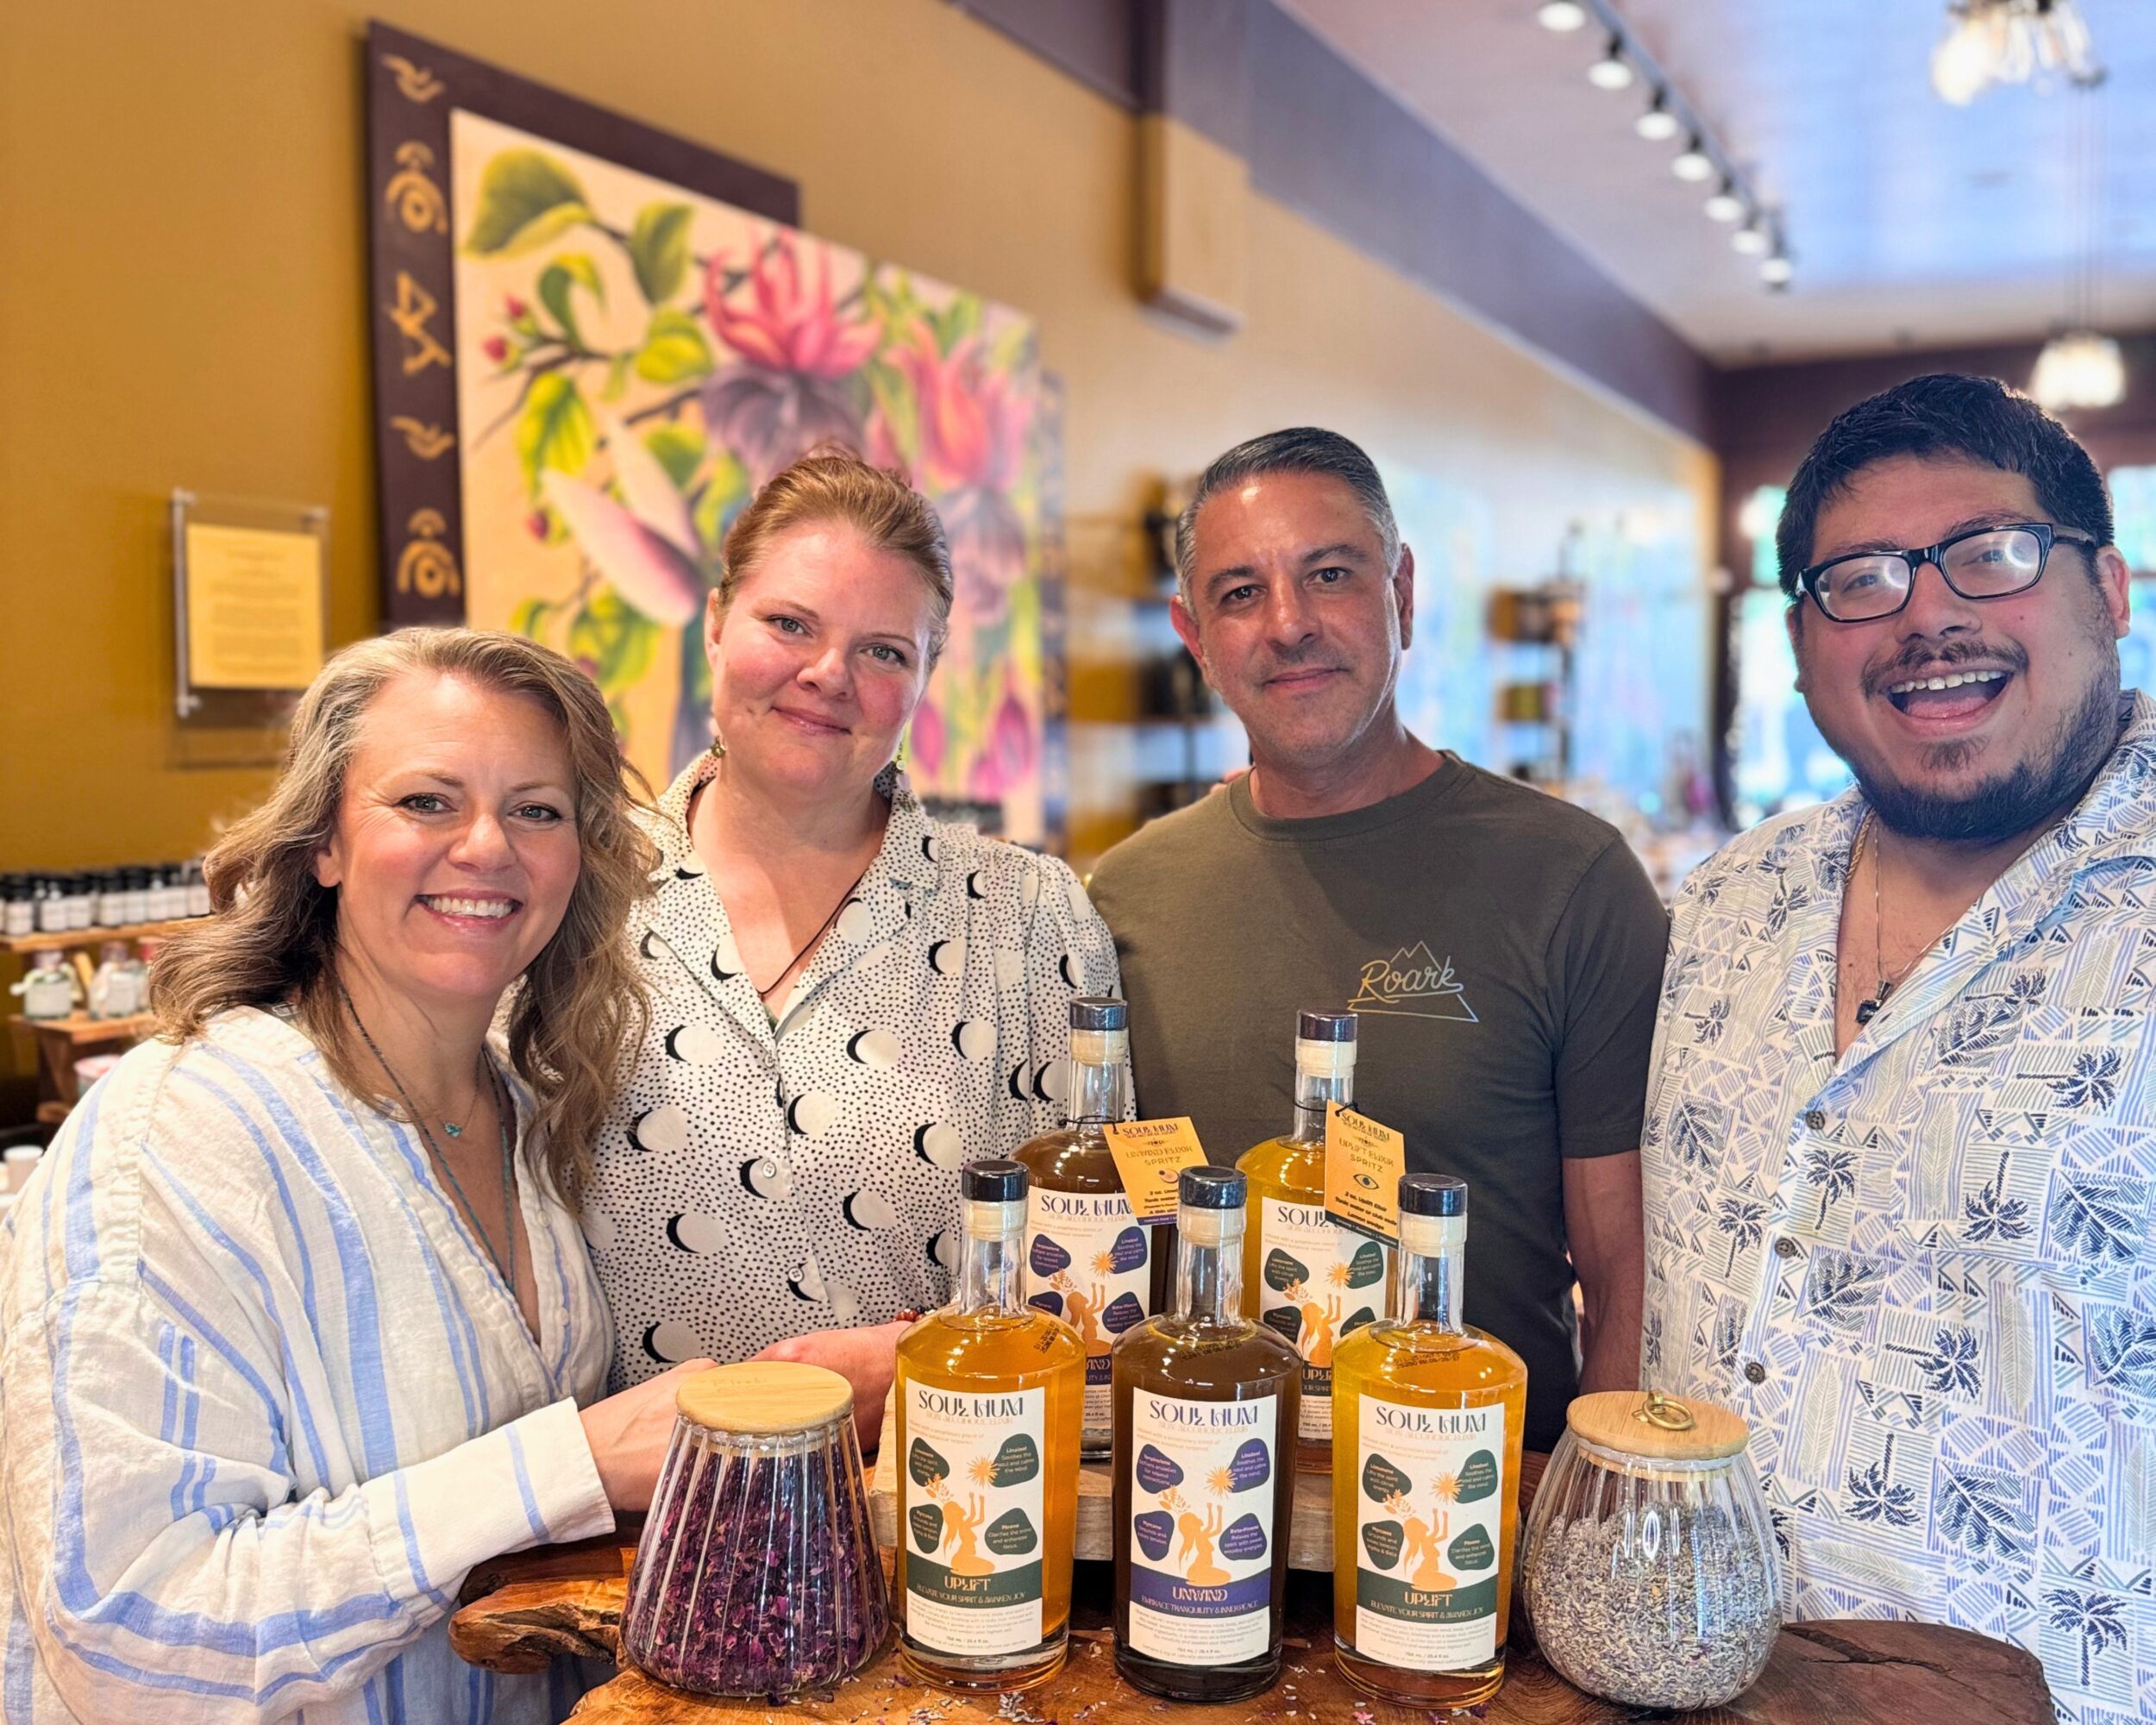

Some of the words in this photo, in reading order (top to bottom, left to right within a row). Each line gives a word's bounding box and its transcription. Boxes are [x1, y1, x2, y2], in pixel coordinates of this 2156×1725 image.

[1358, 955, 1463, 1003] Roark
[1123, 1126, 1151, 1135] SOUL
[1153, 1124, 1178, 1133] HUM
[1341, 1113, 1366, 1130] SOUL
[1368, 1125, 1389, 1141] HUM
[1126, 1149, 1163, 1158] UNWIND
[1164, 1146, 1193, 1154] ELIXIR
[1145, 1156, 1182, 1165] SPRITZ
[1339, 1137, 1367, 1155] UPLIFT
[1368, 1150, 1394, 1167] ELIXIR
[1350, 1154, 1383, 1173] SPRITZ
[1041, 1195, 1089, 1216] SOUL
[1359, 1197, 1373, 1208] Uplift
[1278, 1206, 1329, 1228] SOUL
[1347, 1211, 1366, 1223] Lemon
[1367, 1220, 1384, 1230] wedge
[919, 1390, 968, 1417] SOUL
[974, 1397, 1023, 1418] HUM
[1150, 1400, 1205, 1426] SOUL
[1211, 1406, 1258, 1427] HUM
[1376, 1406, 1433, 1433] SOUL
[1439, 1413, 1486, 1434] HUM
[944, 1575, 991, 1591] UPLIFT
[917, 1584, 939, 1597] ELEVATE
[939, 1592, 957, 1601] YOUR
[958, 1595, 976, 1603] SPIRIT
[984, 1594, 1012, 1604] AWAKEN
[1012, 1591, 1026, 1600] JOY
[1172, 1586, 1228, 1602] UNWIND
[1404, 1591, 1453, 1607] UPLIFT
[1141, 1595, 1168, 1610] EMBRACE
[1170, 1604, 1214, 1614] TRANQUILITY
[1371, 1600, 1396, 1615] ELEVATE
[1397, 1608, 1419, 1618] YOUR
[1419, 1610, 1438, 1619] SPIRIT
